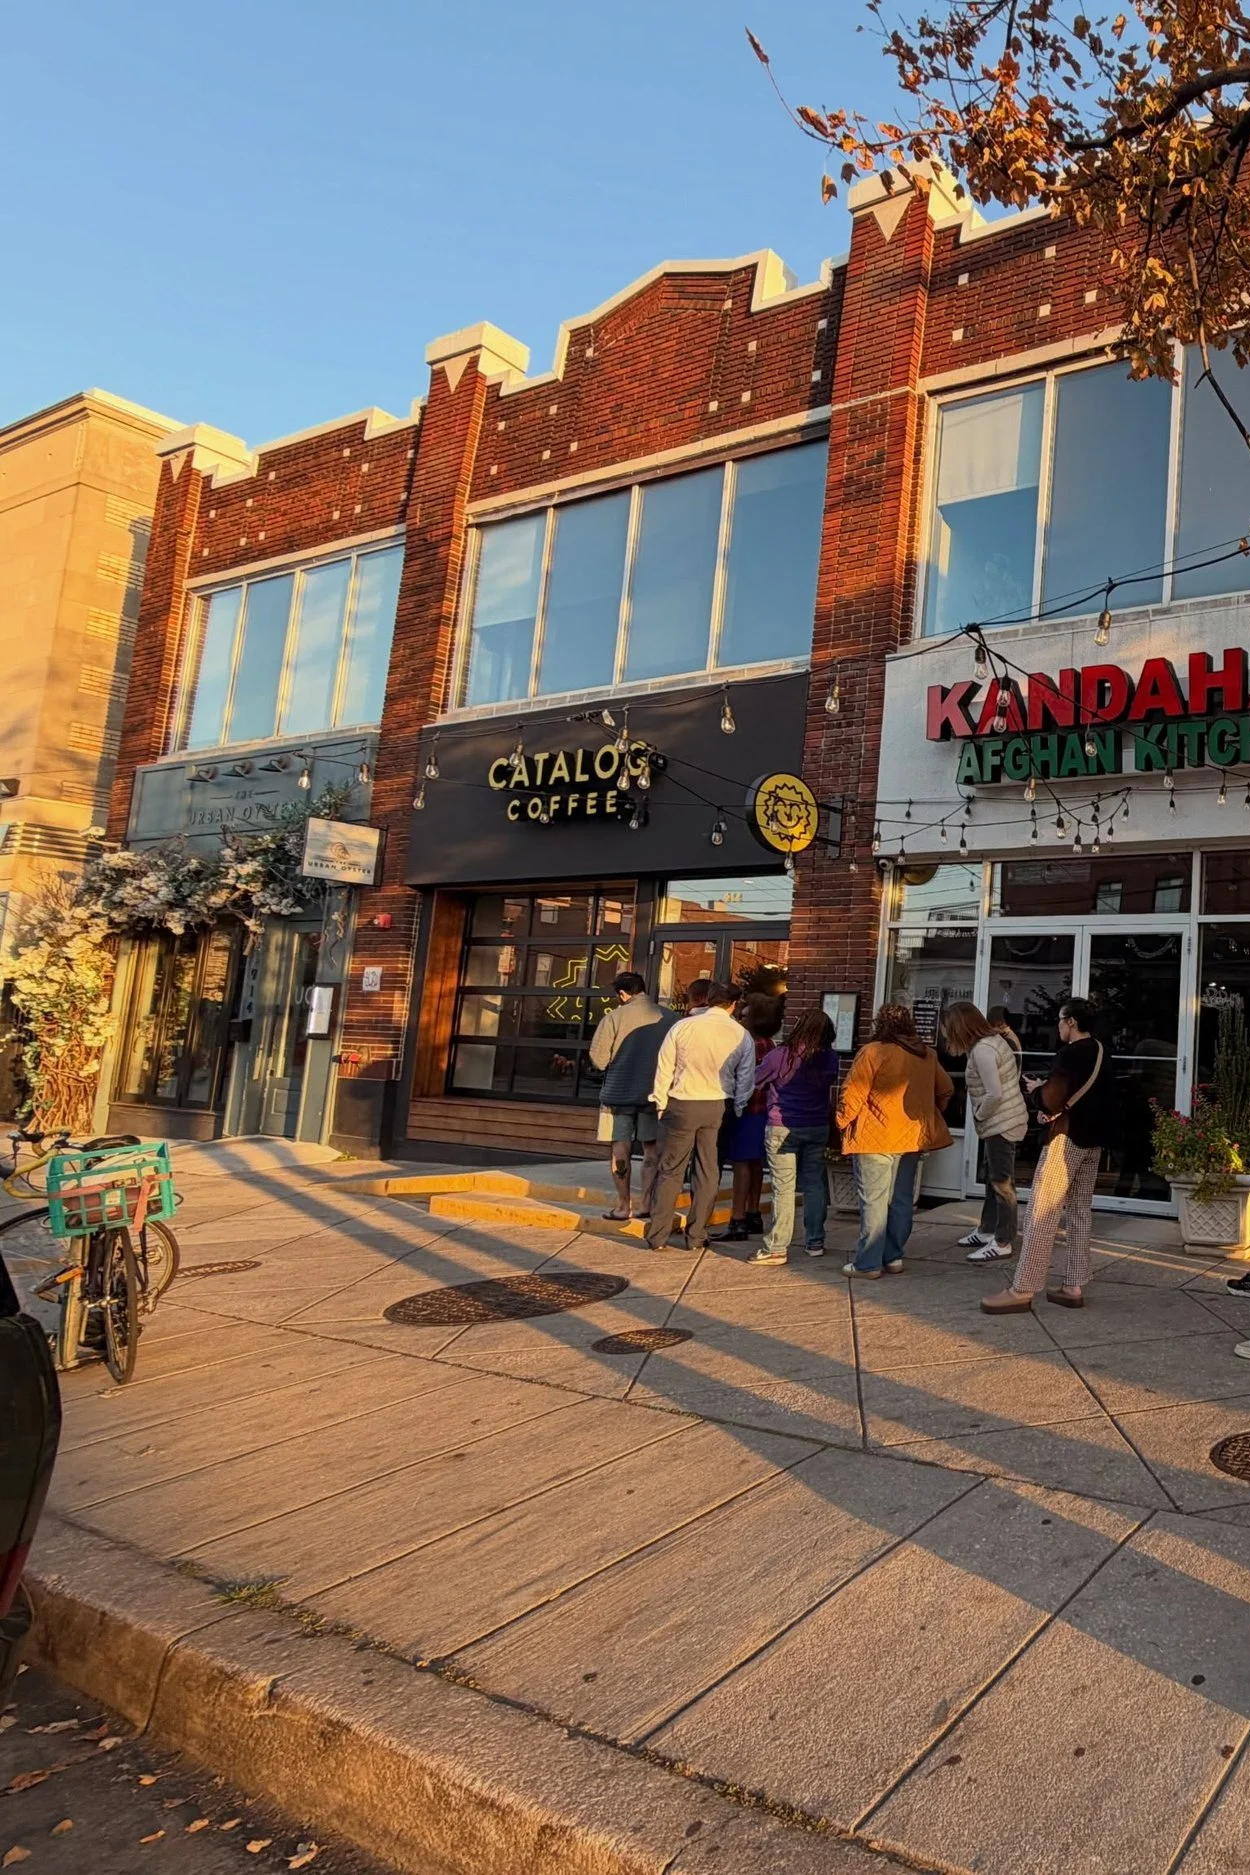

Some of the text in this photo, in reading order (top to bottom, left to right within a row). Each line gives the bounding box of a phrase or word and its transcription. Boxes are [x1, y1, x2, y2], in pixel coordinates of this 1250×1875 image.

[488, 740, 648, 790] CATALOG
[956, 727, 1124, 785] AFGHAN
[507, 790, 618, 821] COFFEE
[307, 861, 371, 874] URBAN OYSTER
